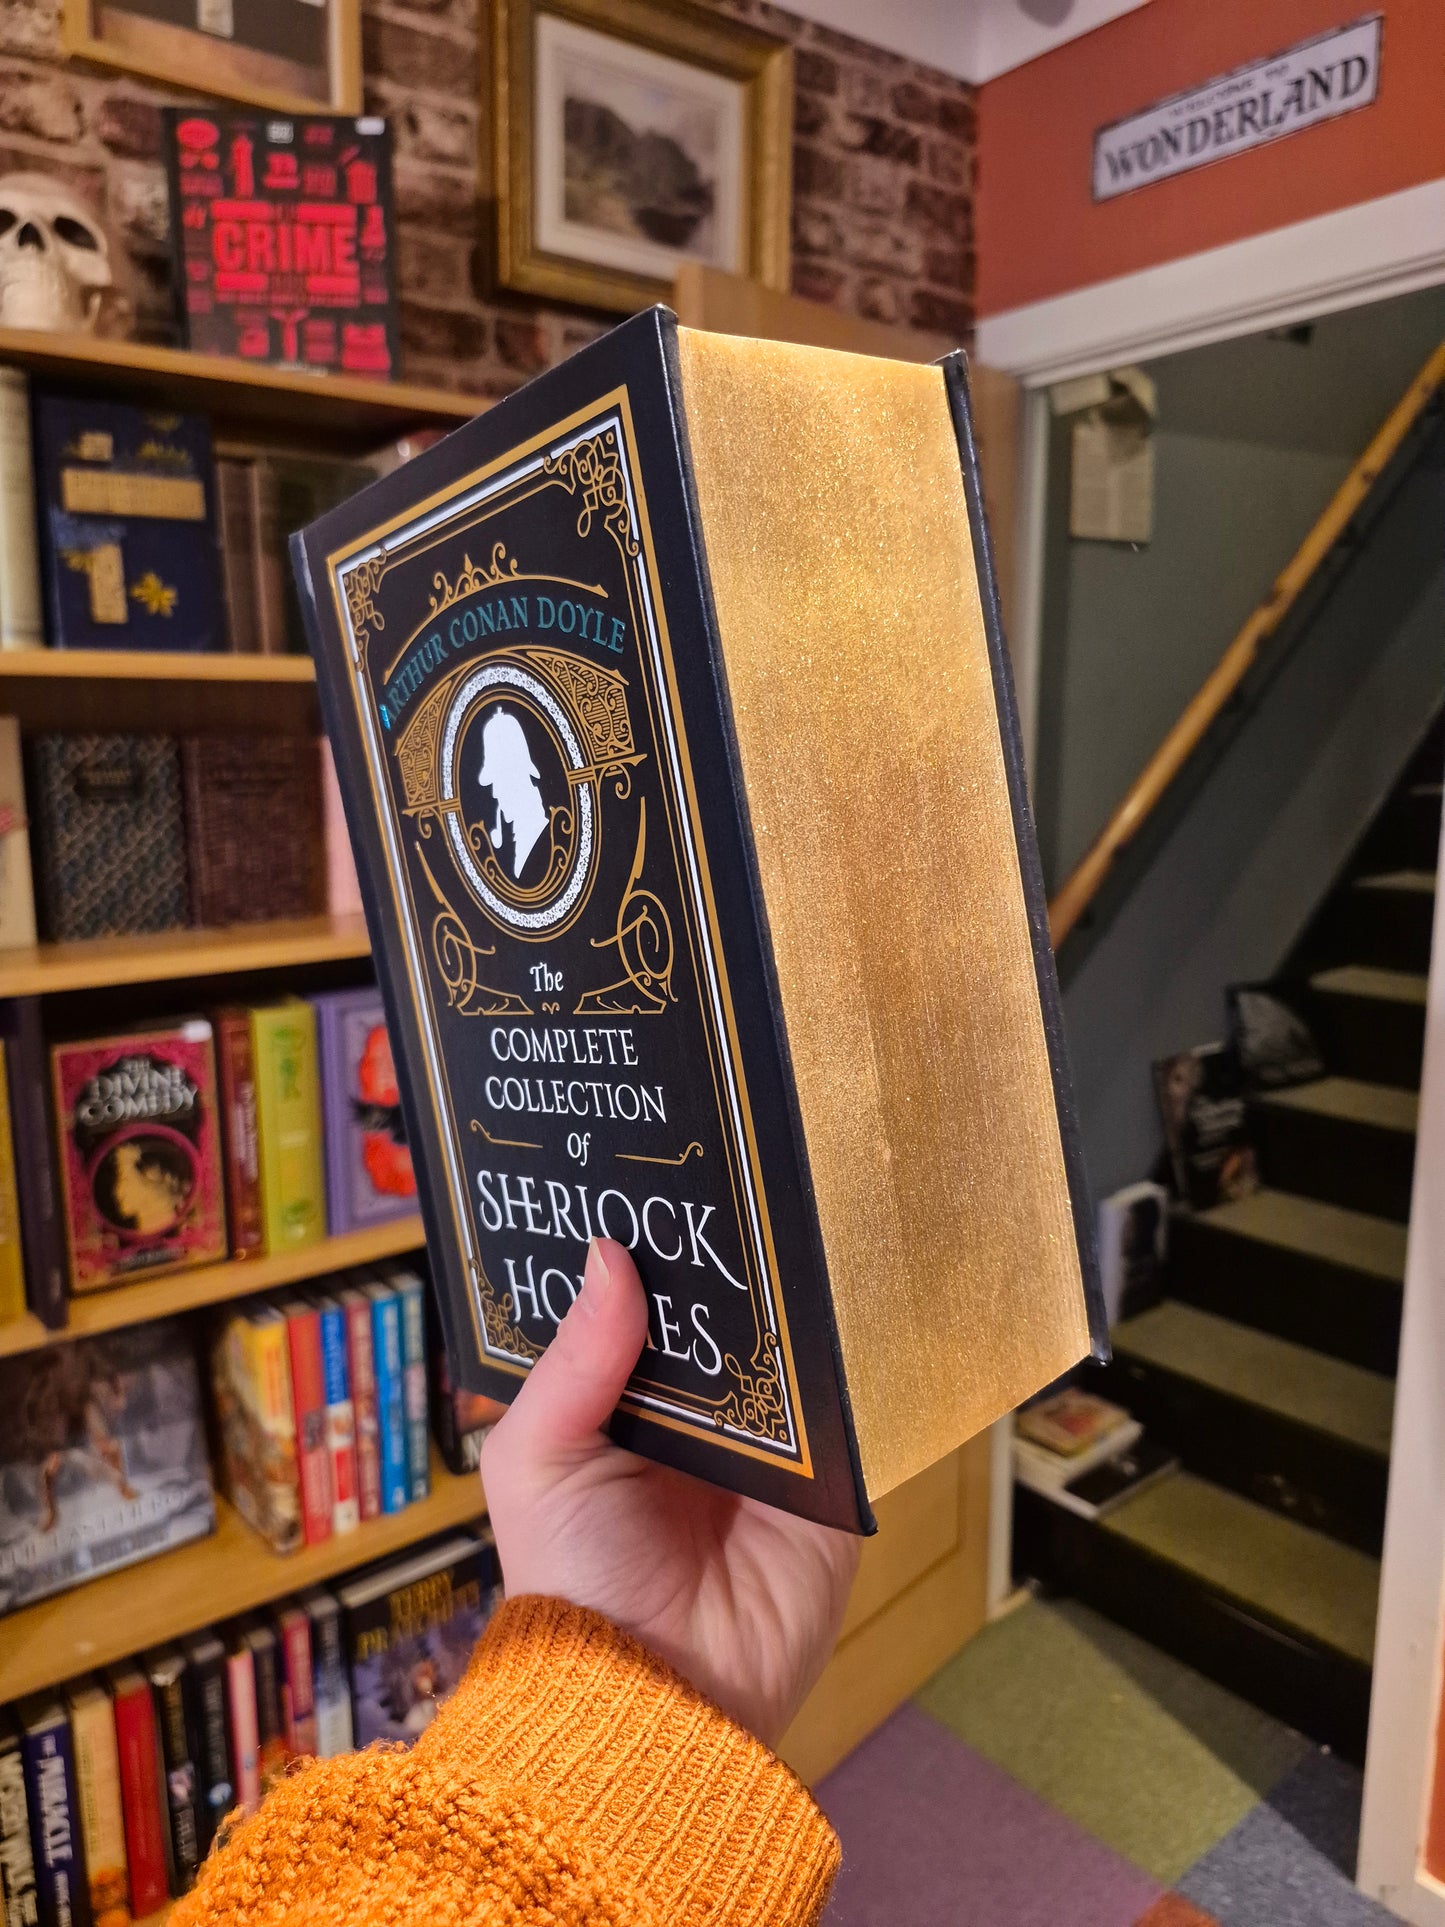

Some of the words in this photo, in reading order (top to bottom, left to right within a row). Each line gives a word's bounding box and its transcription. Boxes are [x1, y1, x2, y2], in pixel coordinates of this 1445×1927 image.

[1104, 56, 1368, 181] WONDERLAND
[212, 220, 360, 273] CRIME
[379, 633, 449, 731] ARTHUR
[449, 596, 529, 650] CONAN
[537, 596, 627, 655] DOYLE
[529, 962, 564, 992] The
[490, 1027, 639, 1067] COMPLETE
[484, 1076, 667, 1124] COLLECTION
[476, 1169, 748, 1291] SHERLOCK
[503, 1254, 722, 1376] HOES
